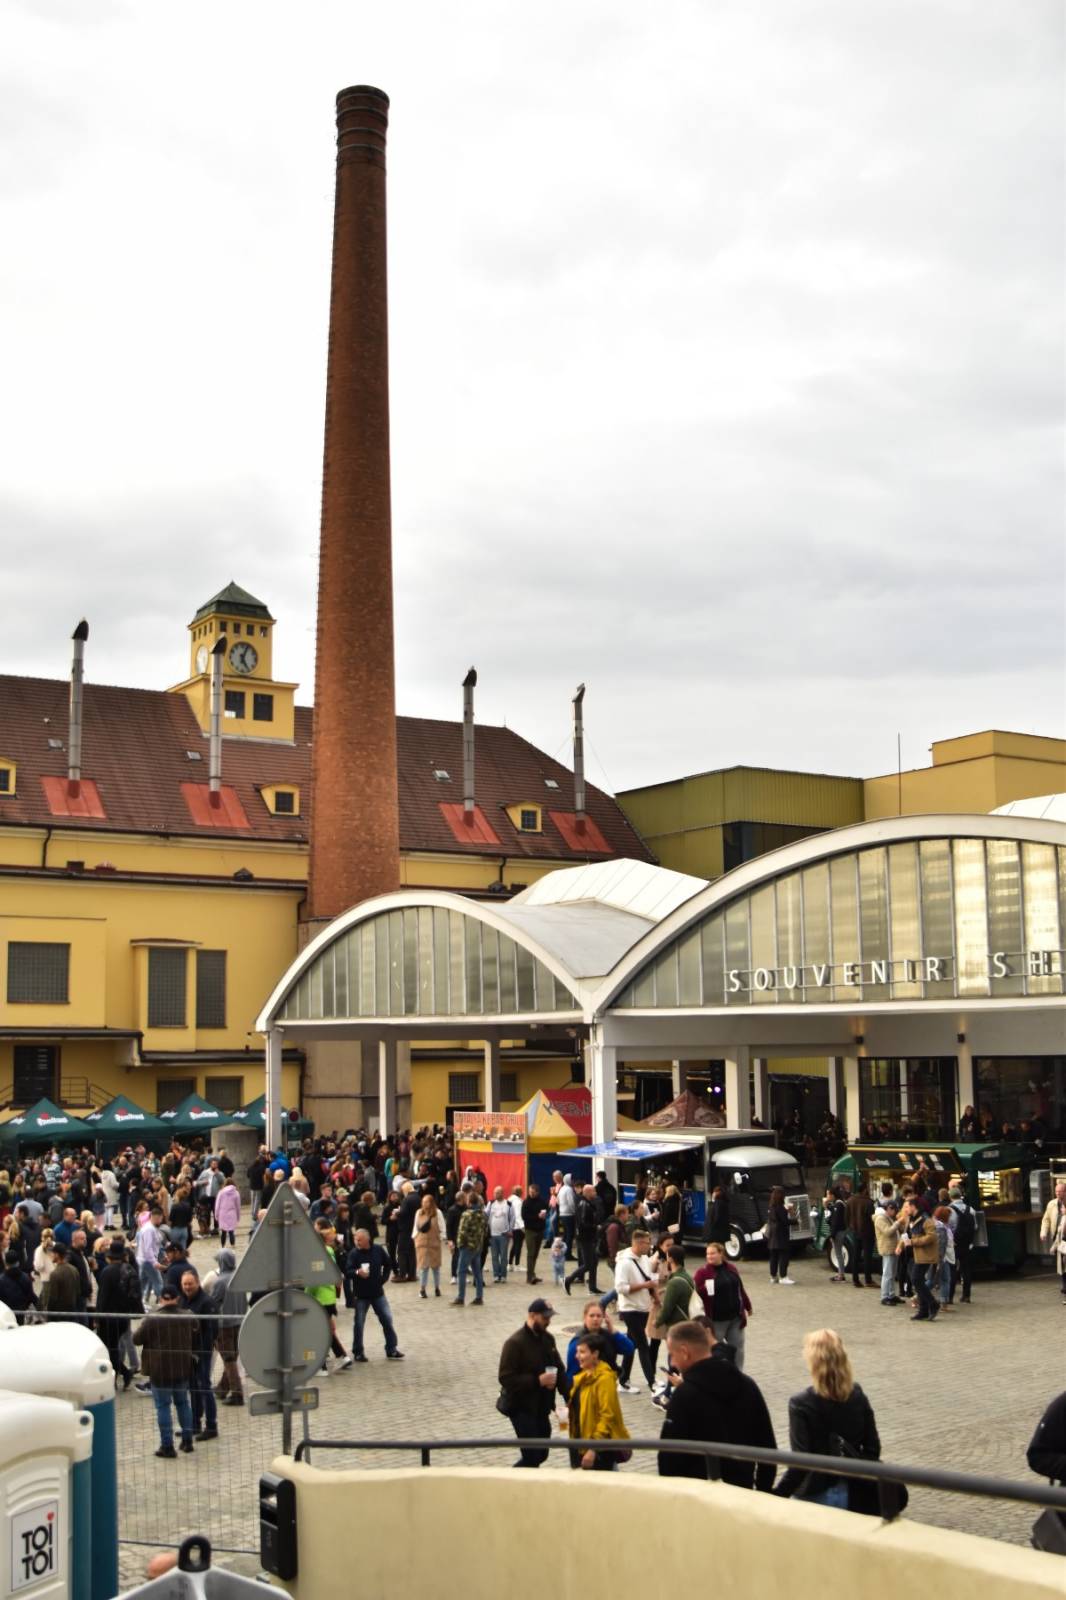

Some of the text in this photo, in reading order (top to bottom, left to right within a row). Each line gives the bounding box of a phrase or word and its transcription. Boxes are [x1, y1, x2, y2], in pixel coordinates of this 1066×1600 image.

[729, 957, 941, 992] SOUVENIR
[21, 1511, 54, 1555] TOI
[21, 1546, 53, 1580] TOI
